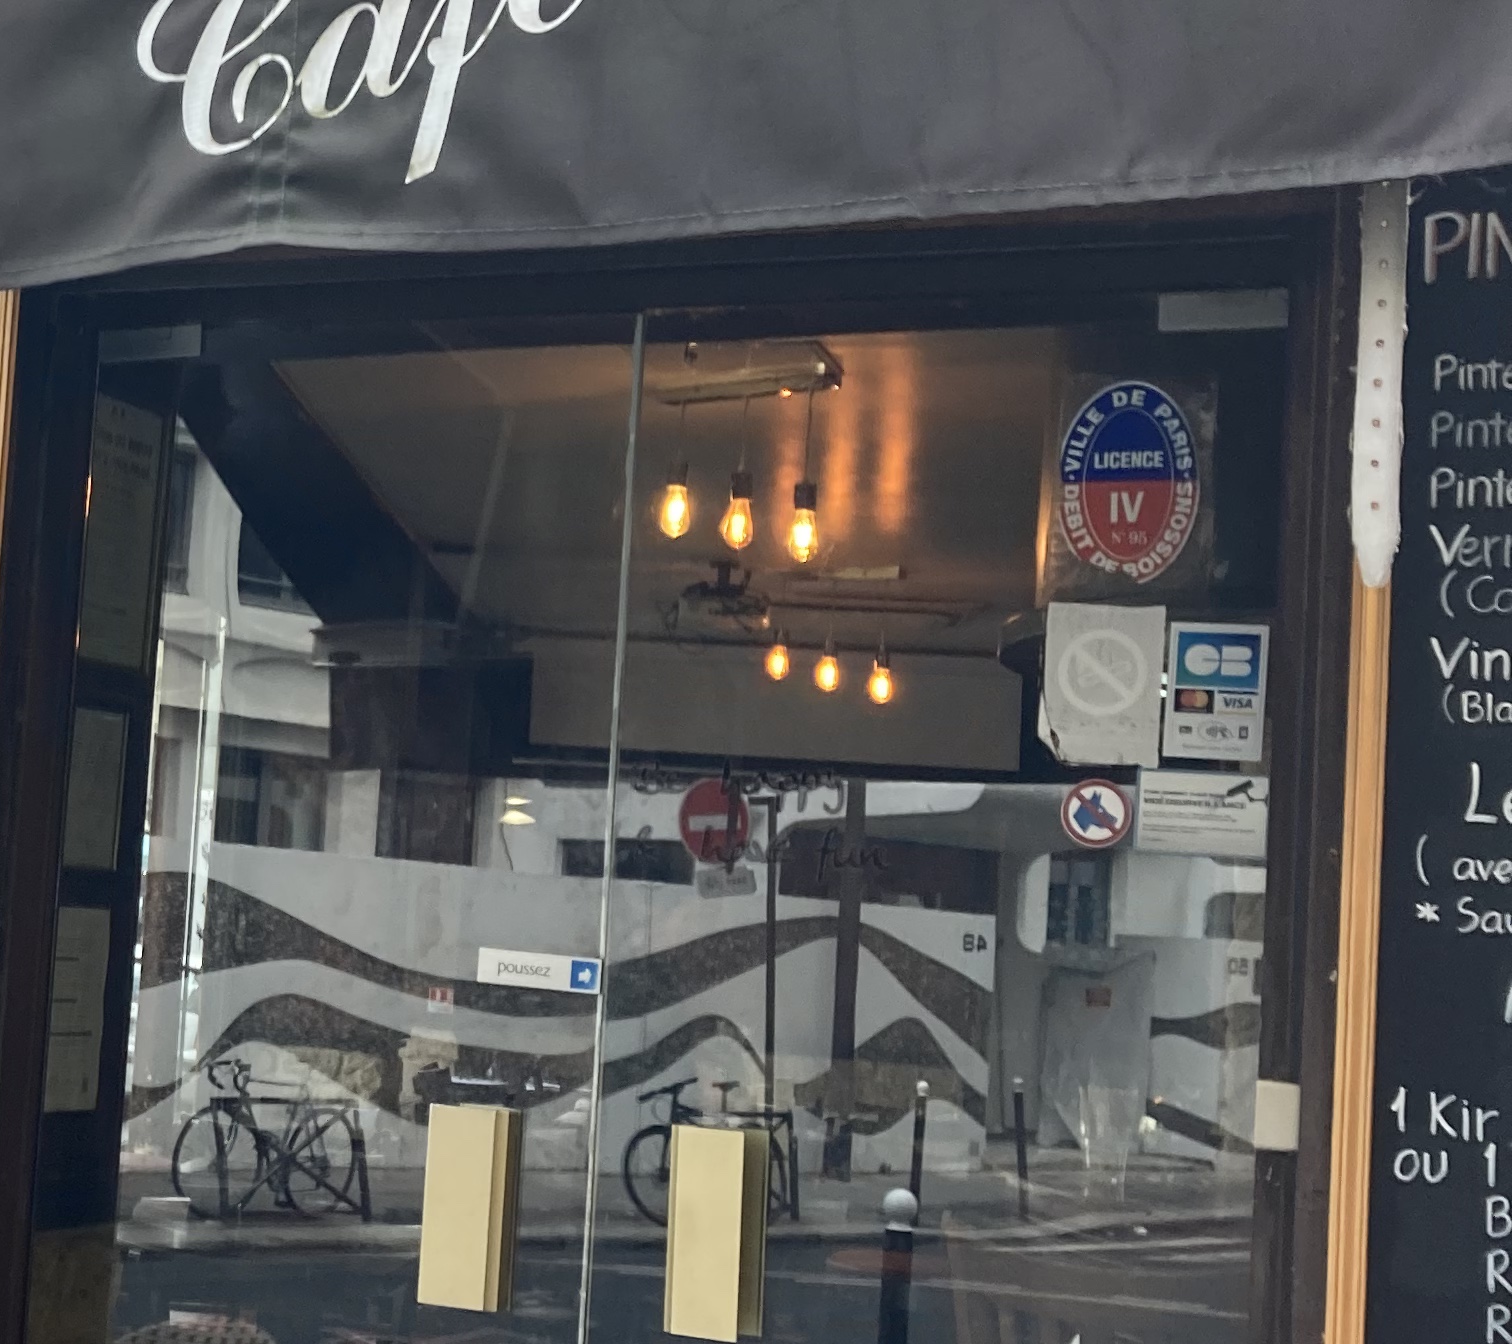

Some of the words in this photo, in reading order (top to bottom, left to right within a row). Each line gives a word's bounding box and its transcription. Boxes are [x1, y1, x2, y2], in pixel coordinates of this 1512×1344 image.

[1064, 406, 1105, 473] VILLE
[1112, 389, 1146, 407] DE
[1154, 403, 1193, 470] PARIS
[1094, 450, 1164, 470] LICENCE
[1064, 484, 1094, 549] DEBIT
[1109, 491, 1144, 524] IV
[1429, 636, 1512, 681] Vin
[1223, 696, 1253, 709] VISA
[497, 960, 551, 978] poussez
[1390, 1085, 1407, 1133] 1
[1430, 1091, 1499, 1143] Kir
[1484, 1142, 1496, 1187] 1
